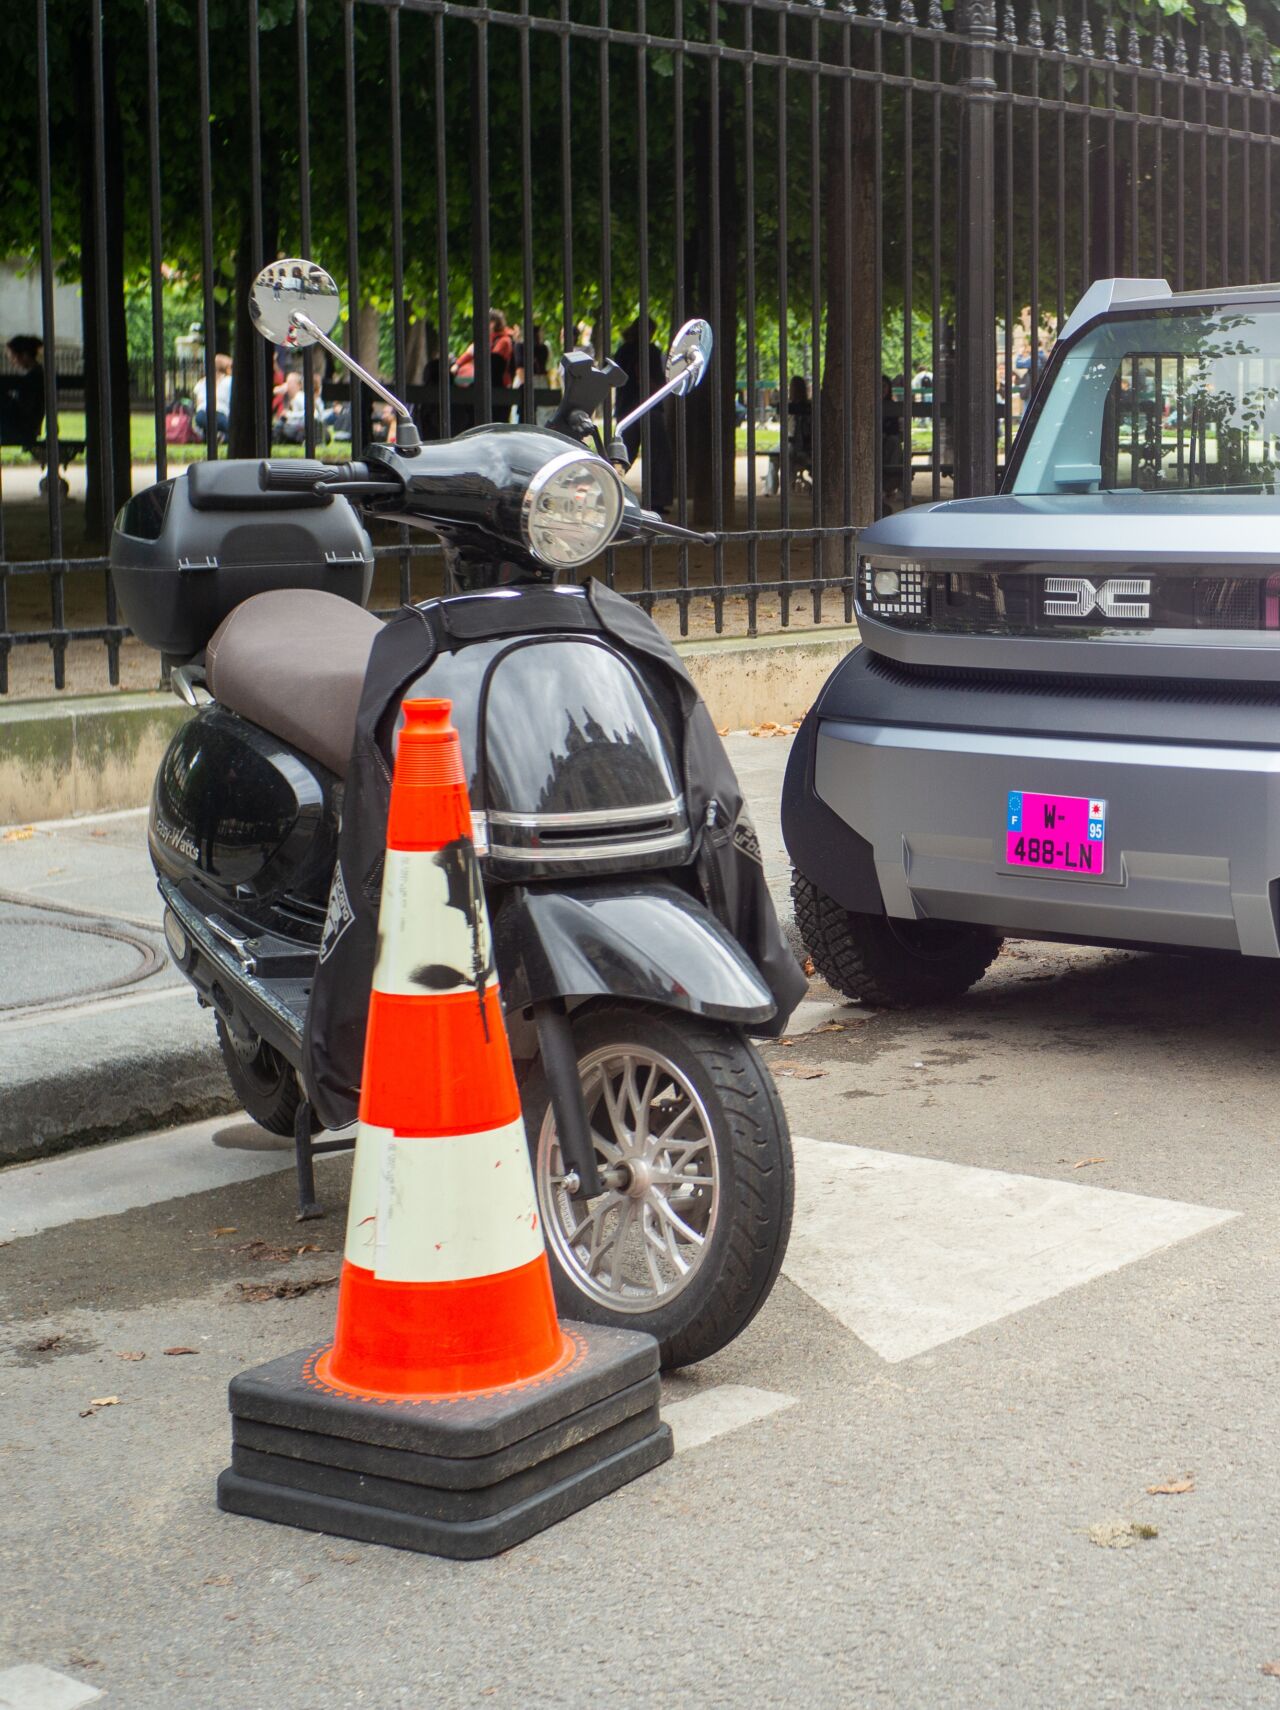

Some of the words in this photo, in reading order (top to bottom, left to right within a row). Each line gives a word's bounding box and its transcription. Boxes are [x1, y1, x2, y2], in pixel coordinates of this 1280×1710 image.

[1012, 816, 1018, 825] F
[1089, 823, 1102, 839] 95
[1015, 837, 1092, 869] 488-LN
